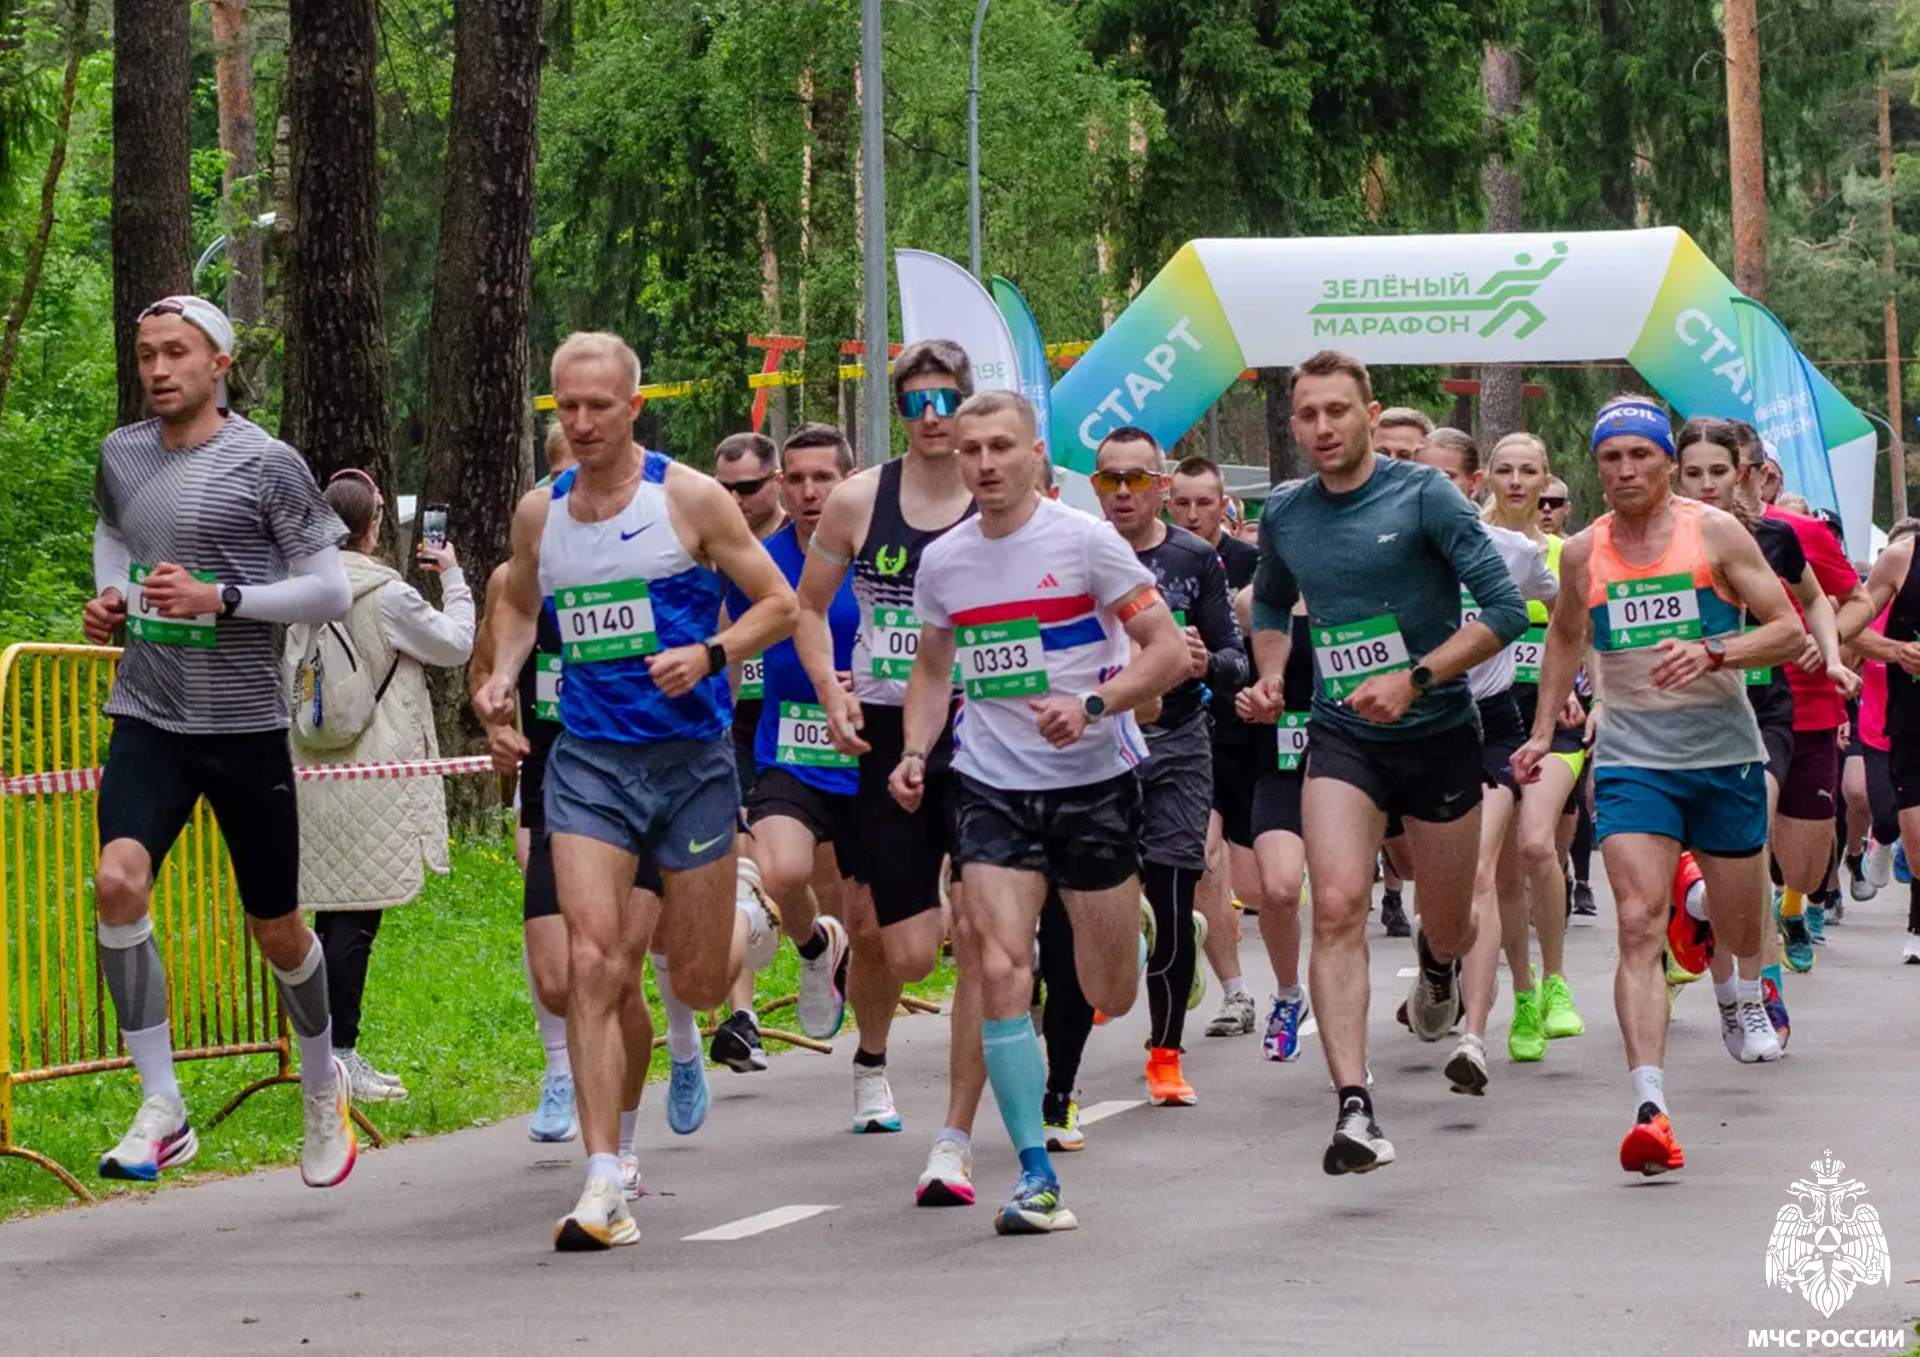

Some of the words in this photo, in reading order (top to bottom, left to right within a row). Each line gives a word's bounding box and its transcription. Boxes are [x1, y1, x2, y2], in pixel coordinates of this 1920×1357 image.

[1322, 272, 1470, 299] ЗЕЛЁНЫЙ
[1313, 315, 1471, 337] МАРАФОН
[1674, 308, 1755, 405] СТА
[1078, 316, 1203, 451] СТАРТ
[572, 605, 635, 636] 0140
[1624, 596, 1682, 623] 0128
[1619, 630, 1632, 644] A
[571, 643, 582, 659] A
[973, 644, 1029, 673] 0333
[1330, 641, 1390, 672] 0108
[973, 680, 983, 696] A
[1332, 679, 1343, 694] A
[1292, 731, 1309, 749] 0
